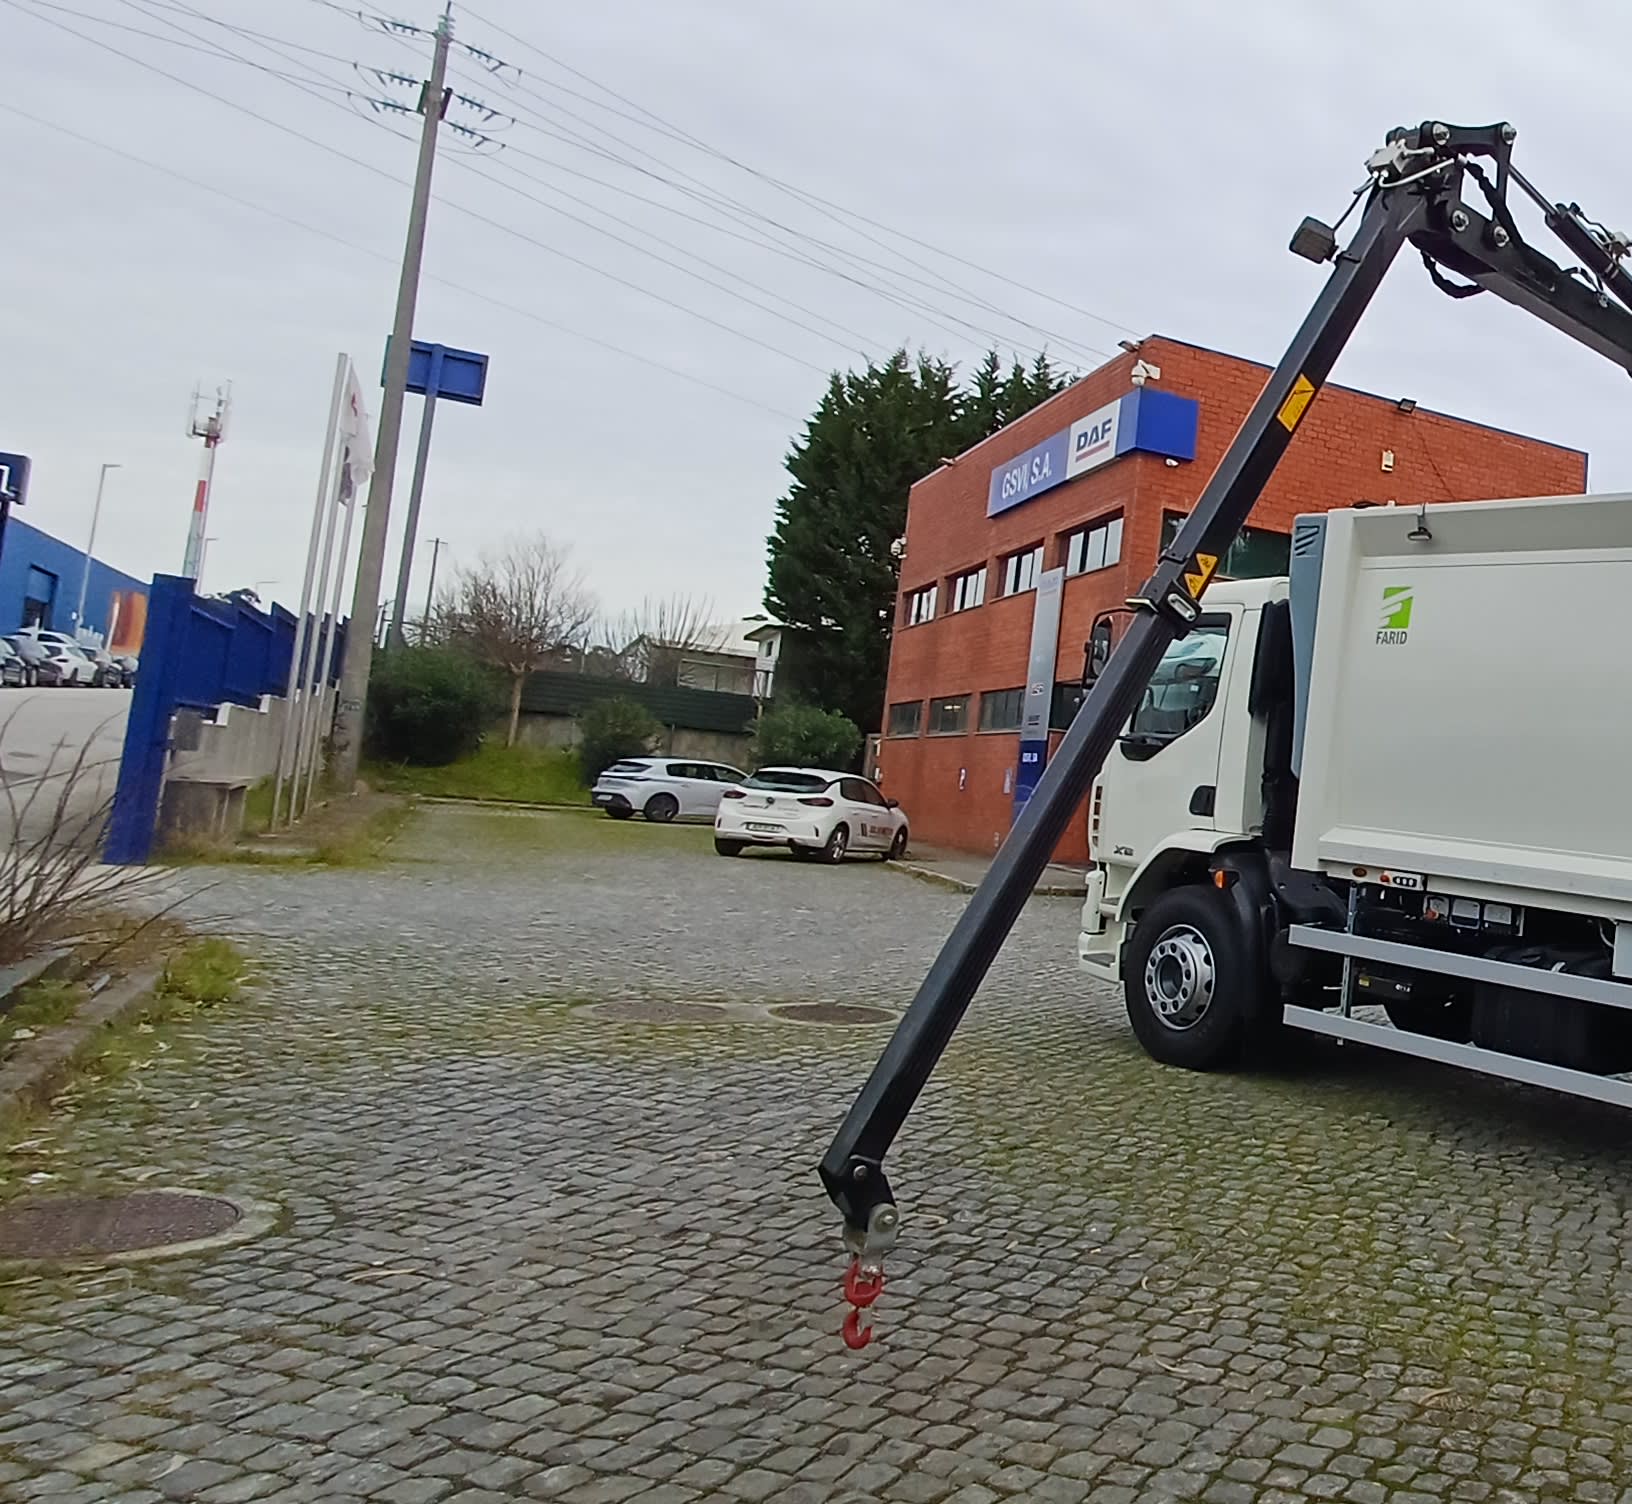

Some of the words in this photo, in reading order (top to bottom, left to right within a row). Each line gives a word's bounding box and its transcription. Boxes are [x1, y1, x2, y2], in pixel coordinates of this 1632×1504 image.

[1075, 418, 1113, 453] DAF
[1030, 452, 1052, 485] S.A.
[1375, 630, 1408, 645] FARID
